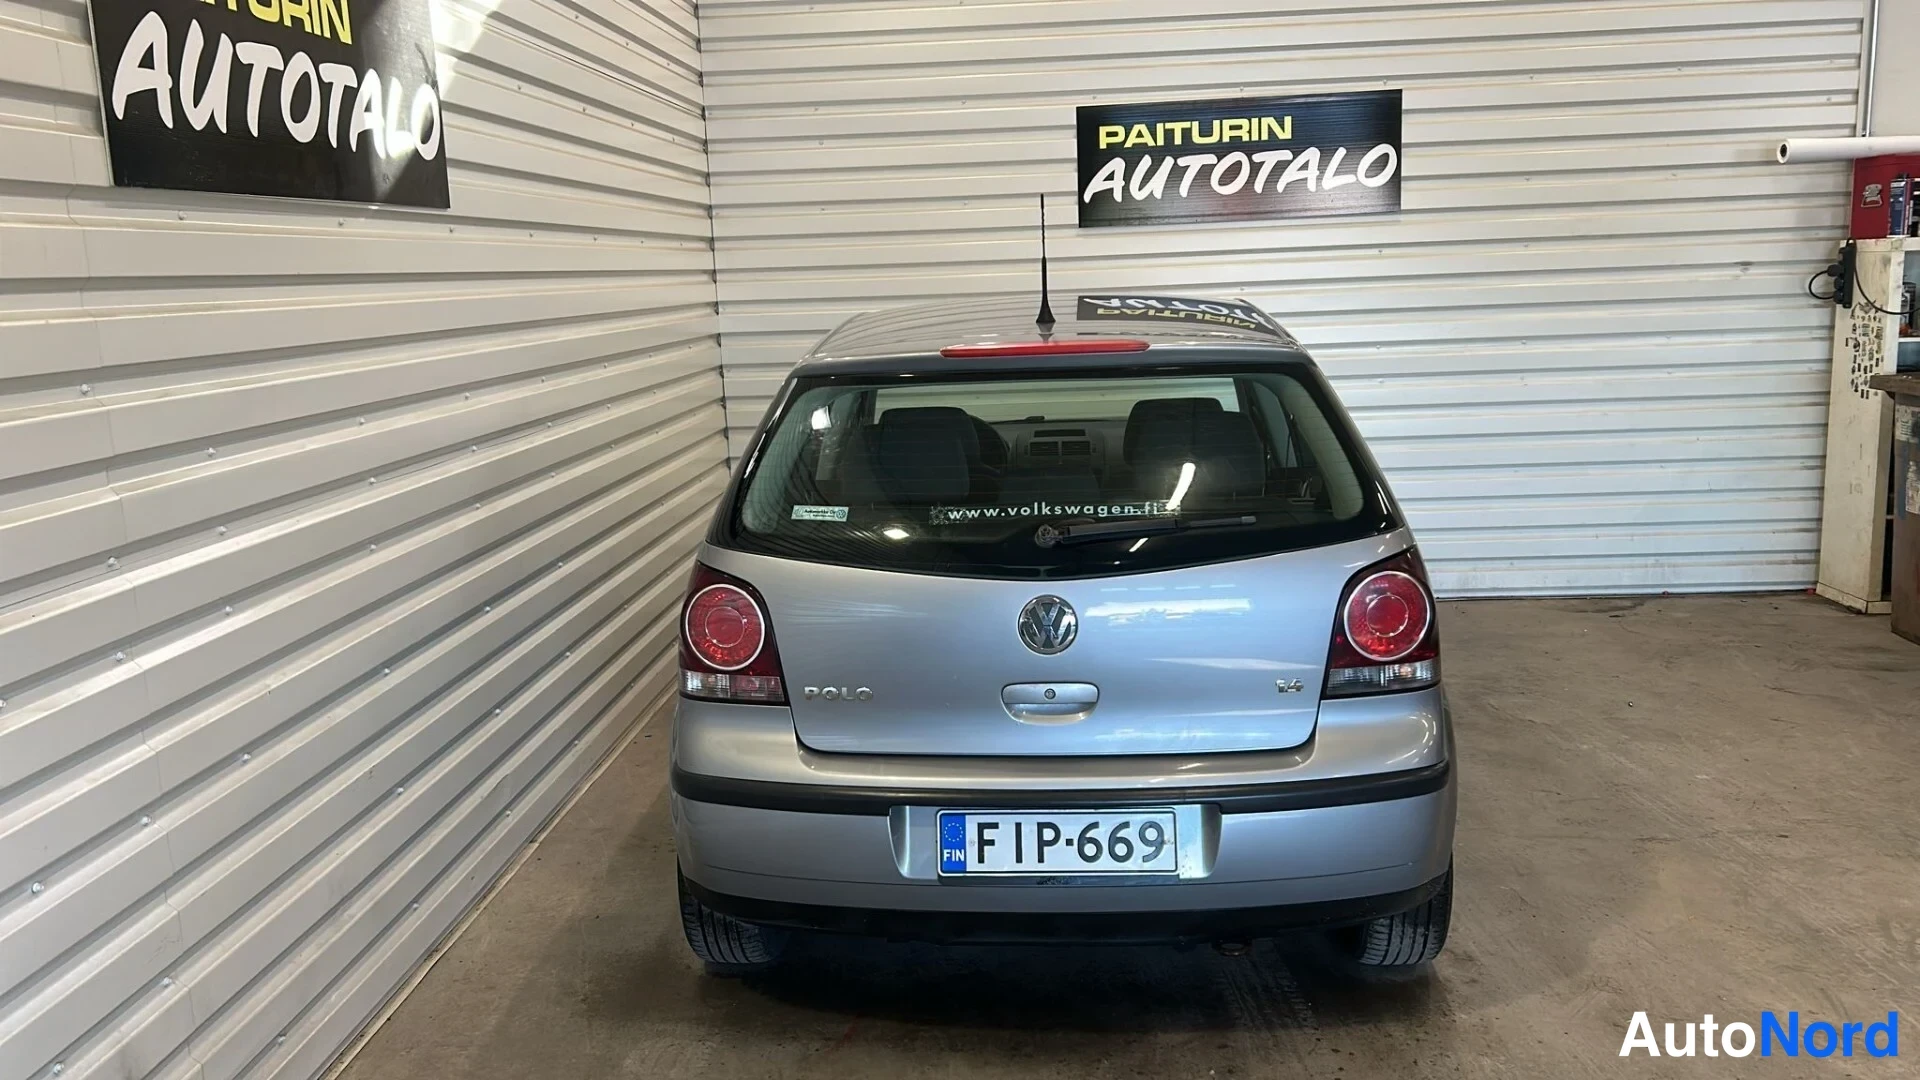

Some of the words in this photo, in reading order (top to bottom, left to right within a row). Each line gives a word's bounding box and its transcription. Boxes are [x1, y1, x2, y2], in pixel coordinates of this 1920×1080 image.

[112, 11, 441, 161] AUTOTALO
[1099, 115, 1292, 149] PAITURIN
[1083, 143, 1397, 203] AUTOTALO
[948, 502, 1159, 519] www.volkswagen.fi
[803, 686, 873, 701] POLO
[943, 849, 965, 862] FIN
[977, 821, 1165, 864] FIP-669
